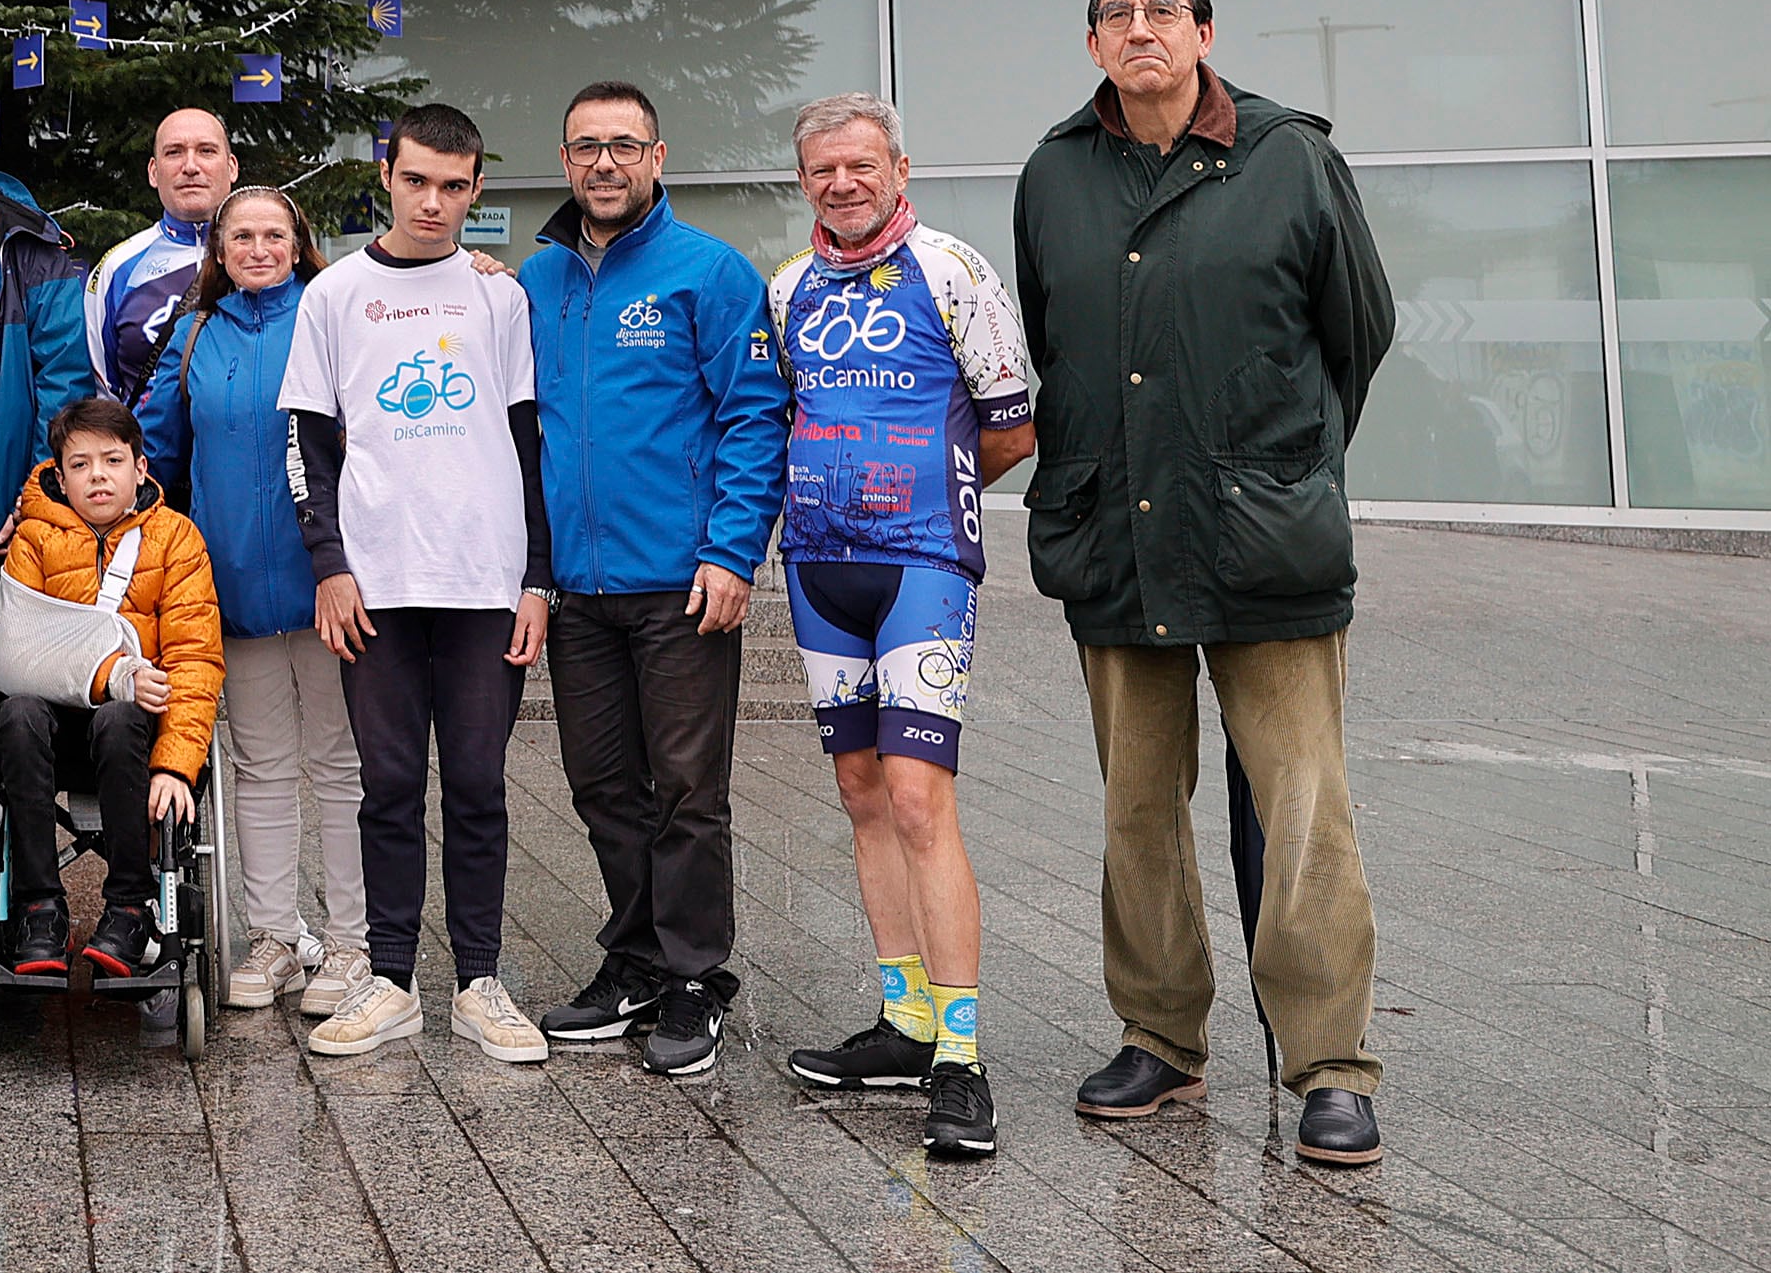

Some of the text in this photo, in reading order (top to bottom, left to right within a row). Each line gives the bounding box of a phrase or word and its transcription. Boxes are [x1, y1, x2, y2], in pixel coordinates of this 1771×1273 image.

[949, 243, 987, 283] RODOSA
[804, 278, 828, 292] ZICO
[386, 304, 430, 322] ribera
[616, 328, 665, 339] discamino
[984, 300, 1006, 363] GRANISA
[622, 337, 666, 349] Santiago
[796, 364, 916, 392] DisCamino
[990, 401, 1029, 422] ZICO
[394, 422, 466, 442] DisCamino
[803, 423, 935, 441] ribera Hospital
[863, 461, 916, 488] 700
[953, 444, 980, 544] ZICO
[903, 726, 945, 744] ZICO
